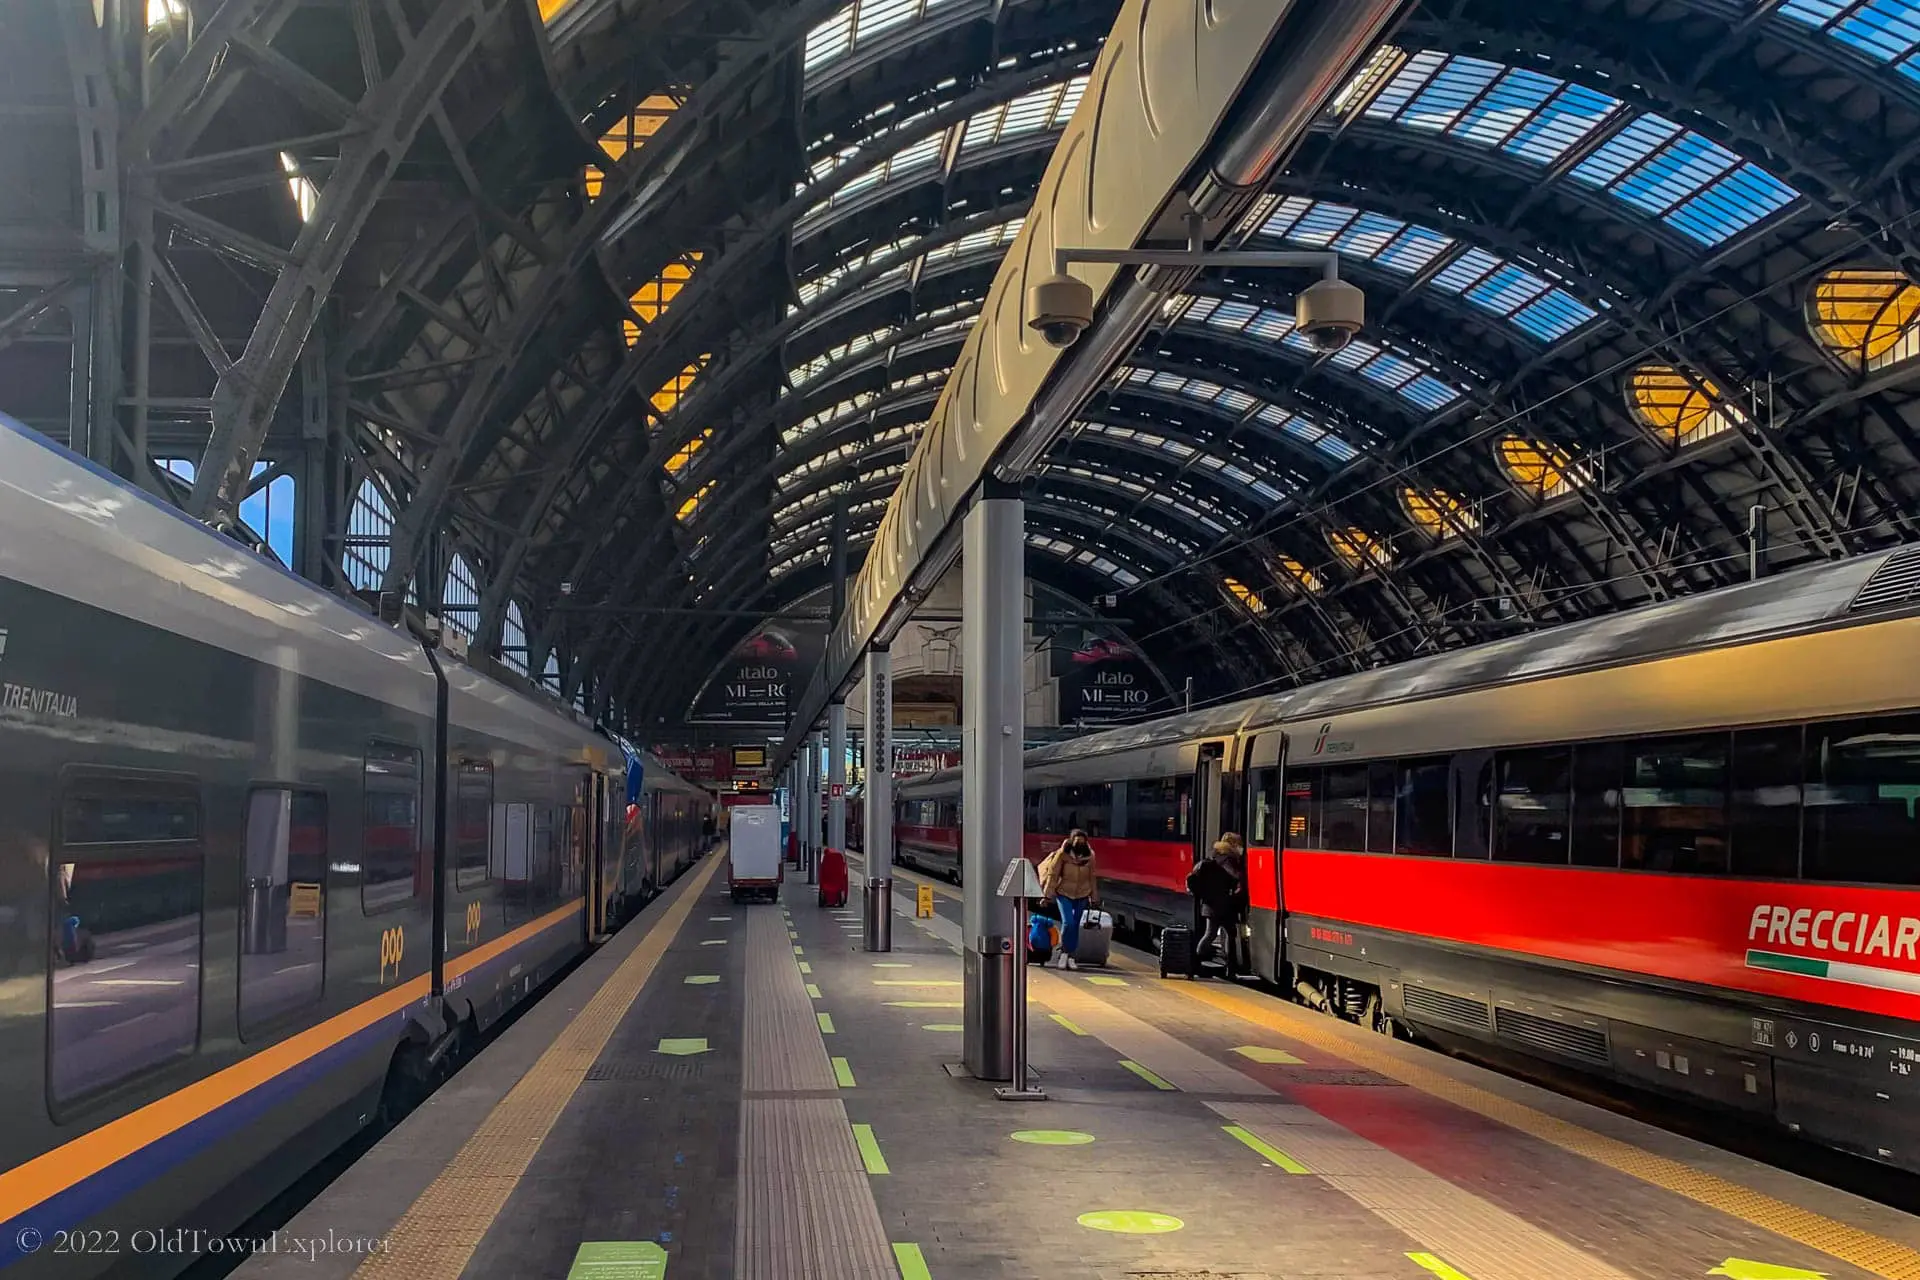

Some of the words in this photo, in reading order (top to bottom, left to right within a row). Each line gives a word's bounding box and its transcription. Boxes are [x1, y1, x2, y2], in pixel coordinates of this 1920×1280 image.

[737, 666, 779, 680] italo
[1094, 671, 1134, 685] italo
[3, 682, 78, 718] TRENITALIA
[466, 900, 480, 944] pop
[1748, 904, 1920, 961] FRECCIAR
[380, 925, 403, 982] pop
